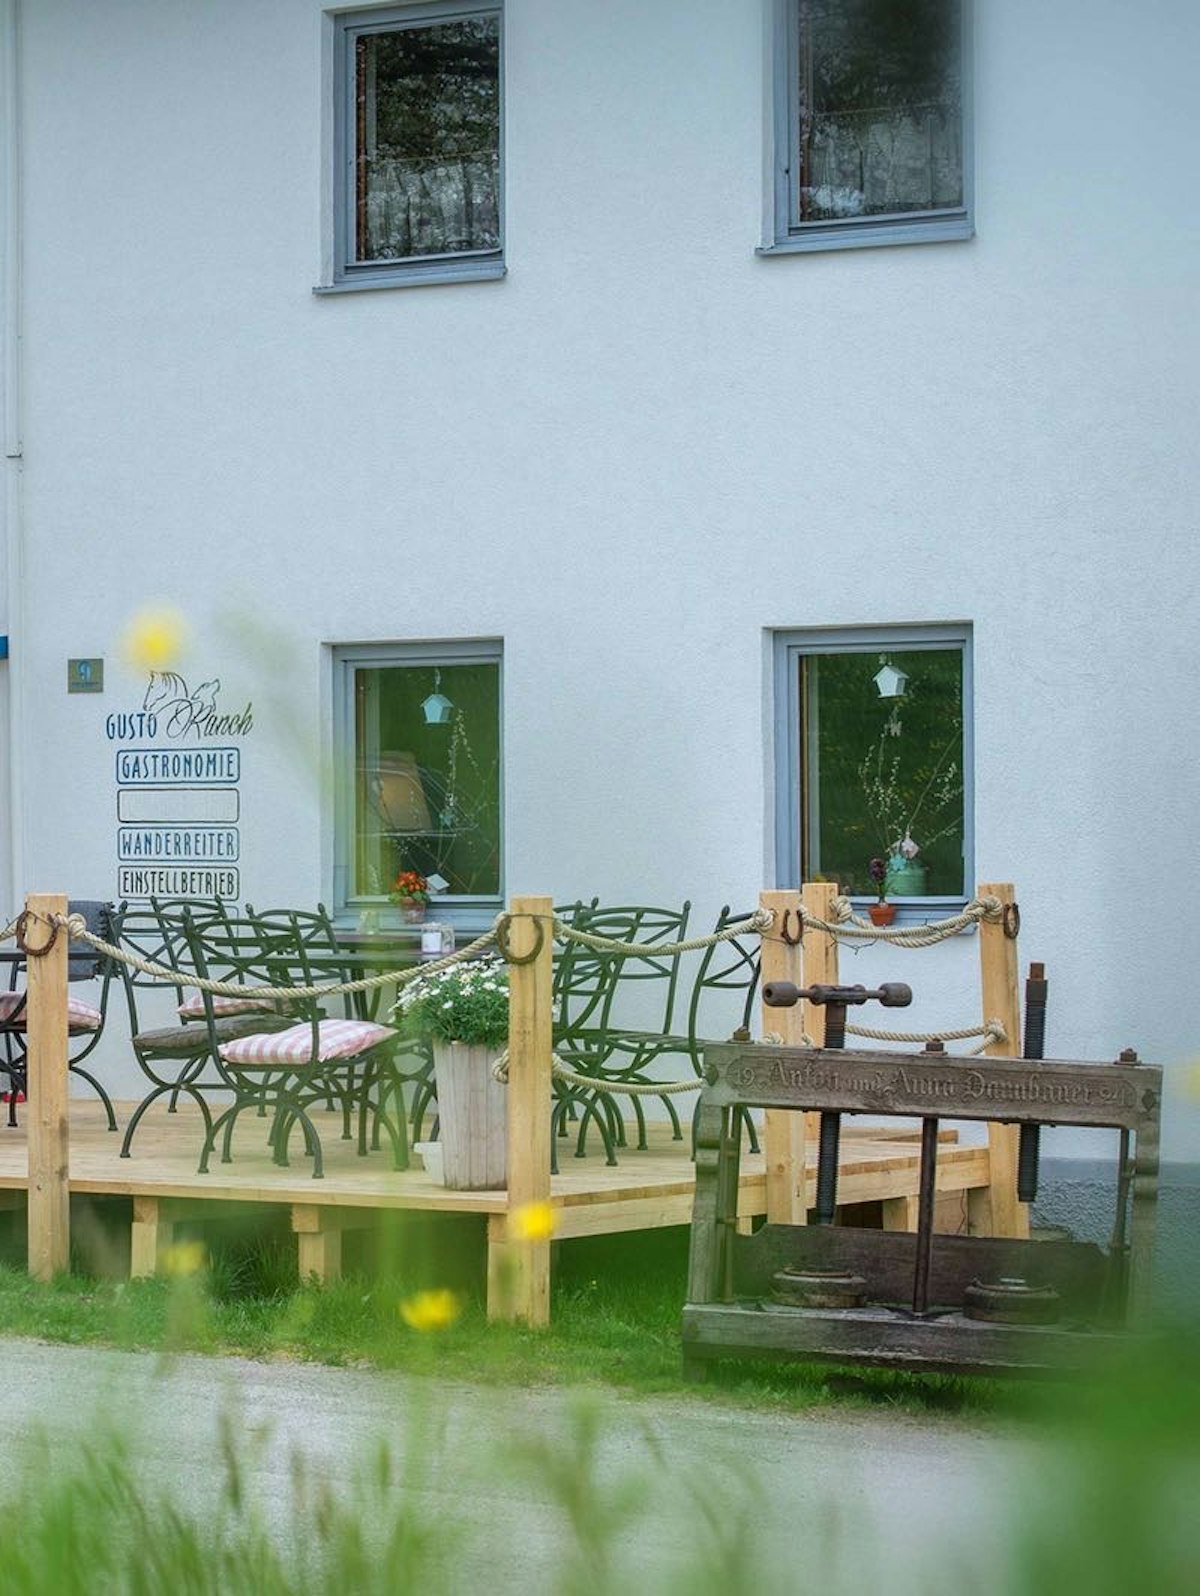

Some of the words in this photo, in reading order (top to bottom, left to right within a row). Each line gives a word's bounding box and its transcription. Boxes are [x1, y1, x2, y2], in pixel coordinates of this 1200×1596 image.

[106, 711, 158, 740] GUSTO
[164, 698, 254, 740] Ranch
[121, 752, 235, 779] GASTRONOMIE
[121, 833, 235, 857] WANDERREITER
[122, 871, 235, 896] EINSTELLBETRIEB
